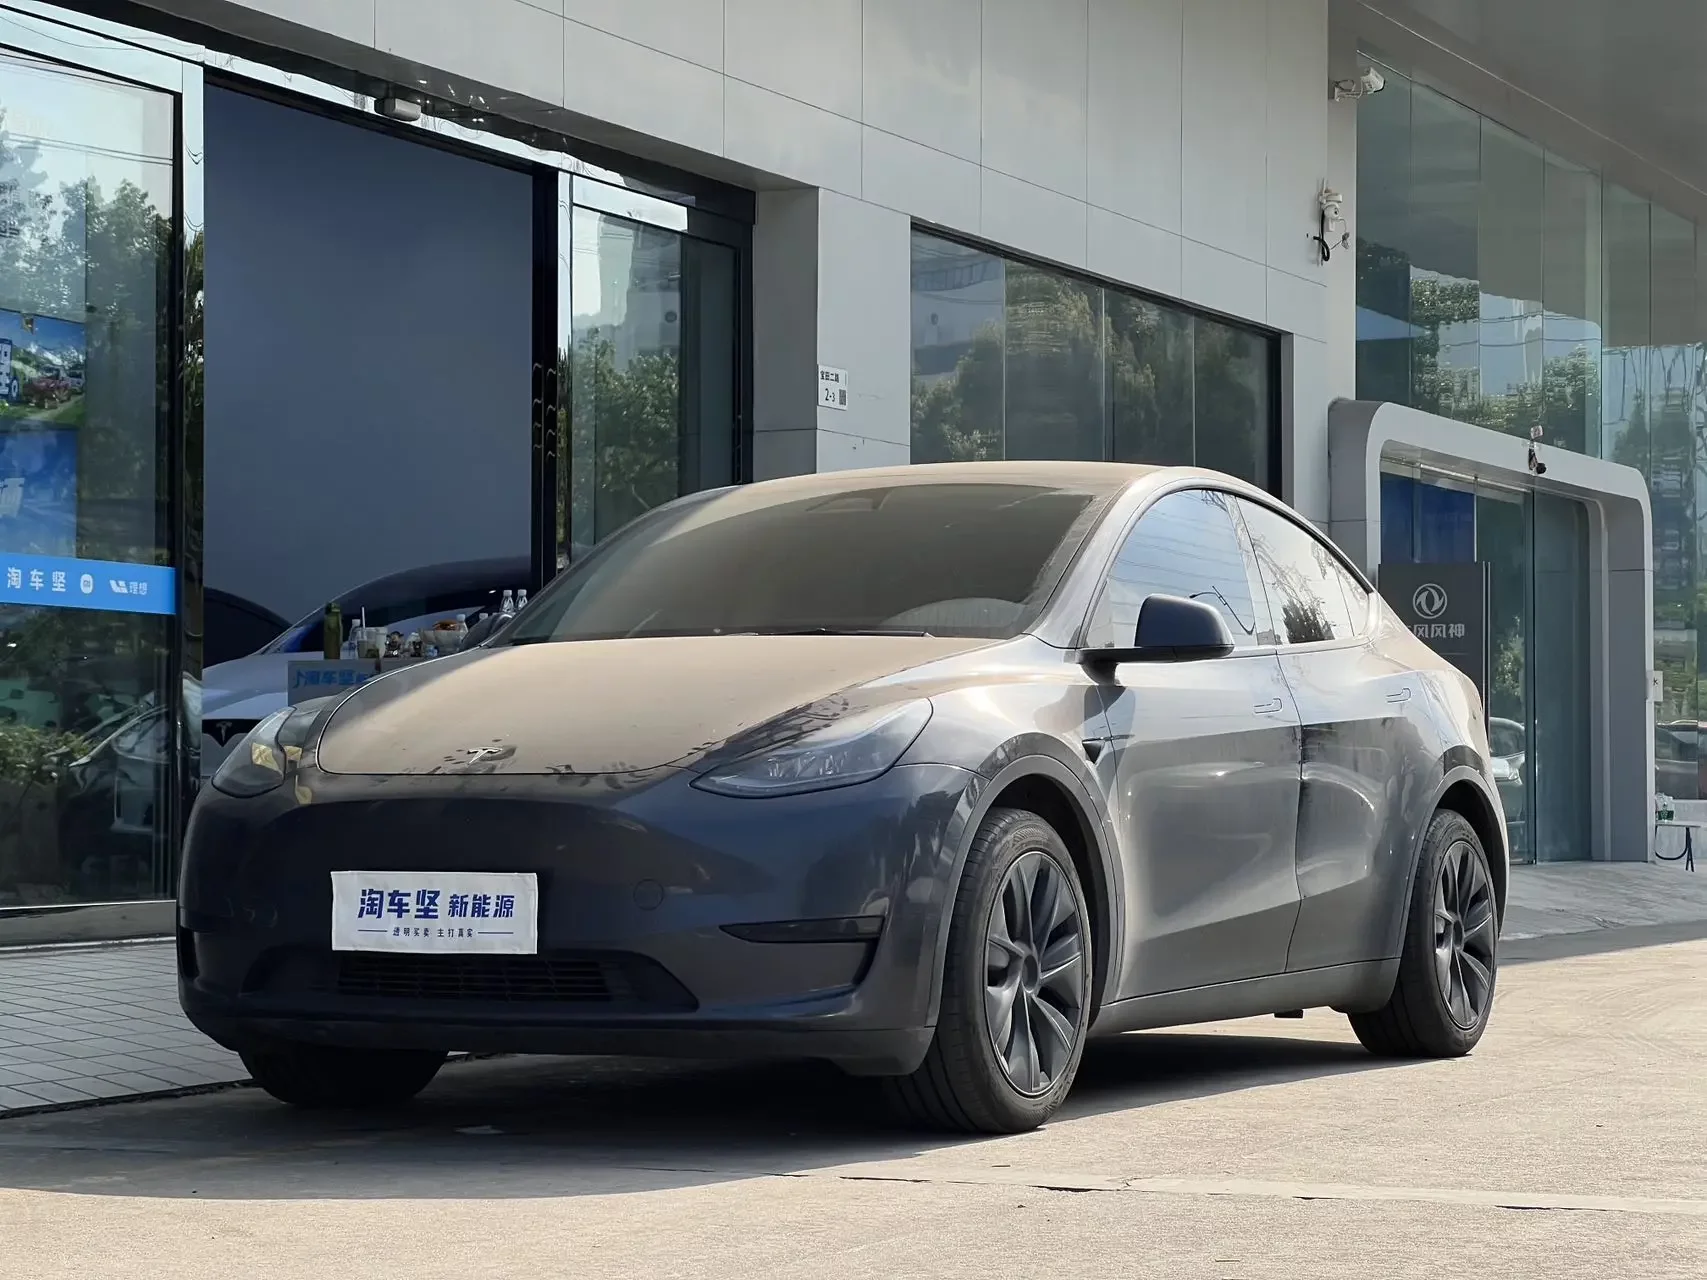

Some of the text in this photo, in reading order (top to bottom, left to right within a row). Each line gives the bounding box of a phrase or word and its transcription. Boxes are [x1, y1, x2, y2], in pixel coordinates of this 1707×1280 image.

[7, 566, 67, 592] 淘车坚
[1408, 623, 1466, 639] 风风神
[357, 888, 515, 920] 淘车坚 新能源
[392, 926, 474, 938] 透明买卖 主打真实
